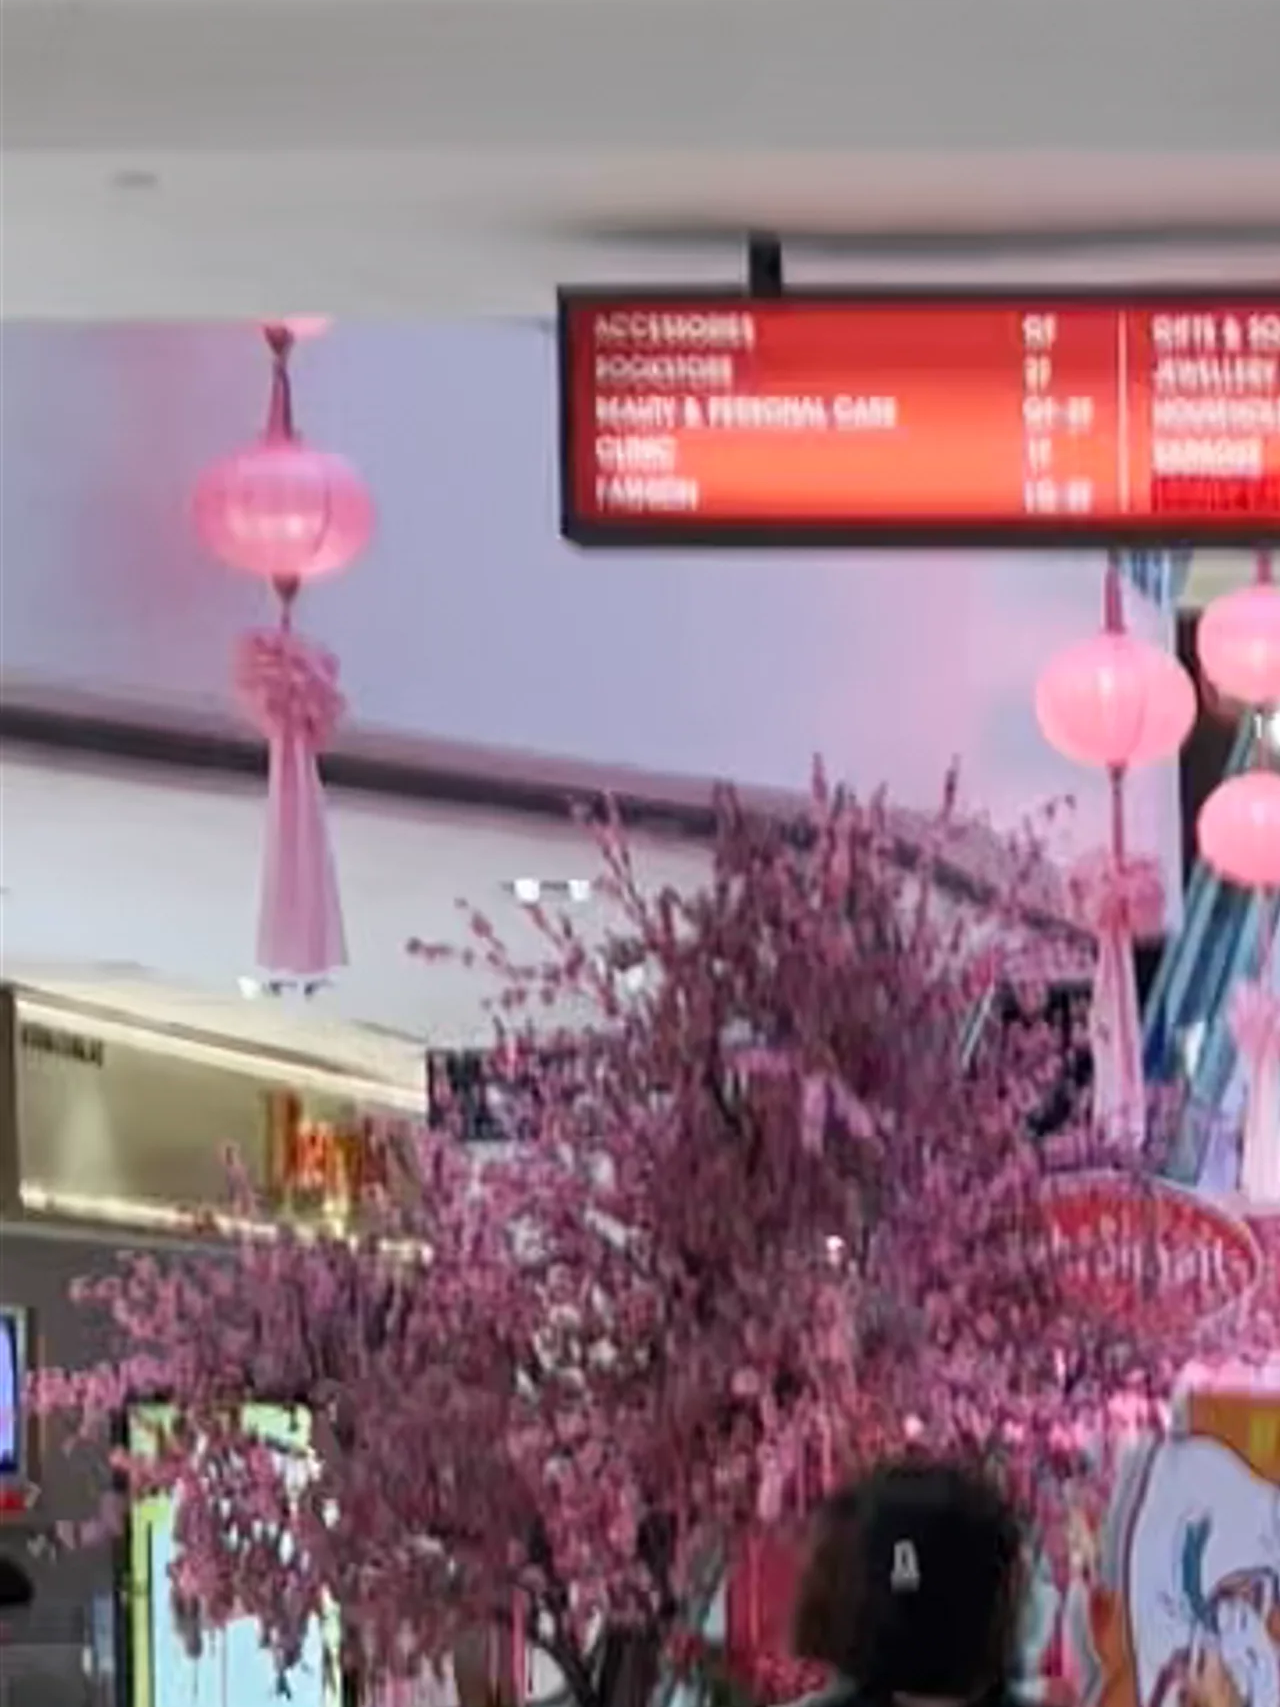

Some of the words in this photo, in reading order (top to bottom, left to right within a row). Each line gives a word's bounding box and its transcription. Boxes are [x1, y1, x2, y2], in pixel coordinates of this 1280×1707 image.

[594, 311, 755, 347] ACCESSORIES
[1223, 314, 1243, 353] &
[595, 395, 676, 429] BEAUTY
[683, 395, 703, 429] &
[707, 395, 827, 429] PERSONAL
[832, 395, 897, 430] CARE
